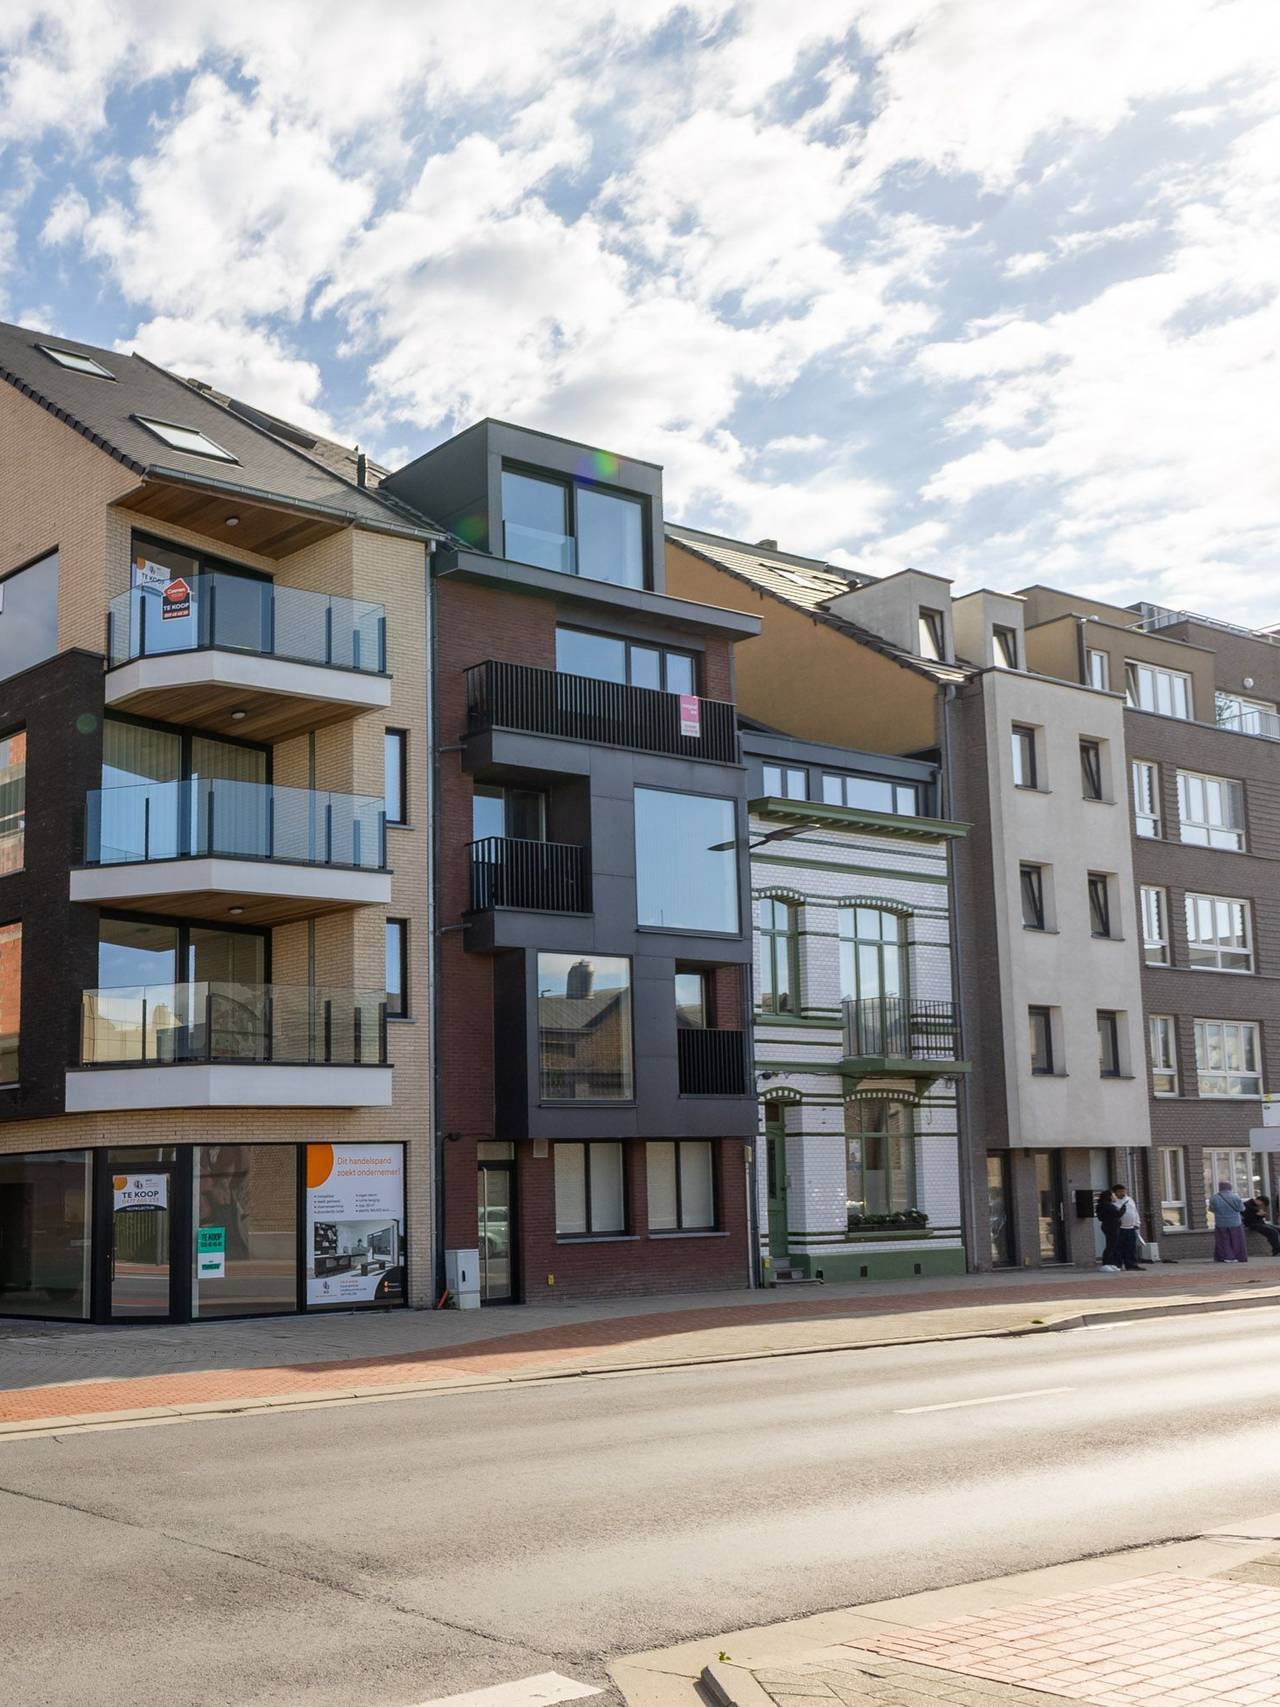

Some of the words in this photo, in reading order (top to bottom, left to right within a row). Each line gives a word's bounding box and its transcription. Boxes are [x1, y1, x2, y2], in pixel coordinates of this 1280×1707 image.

[337, 1157, 347, 1166] Dit
[348, 1156, 392, 1166] handelspand
[337, 1169, 356, 1177] zoekt
